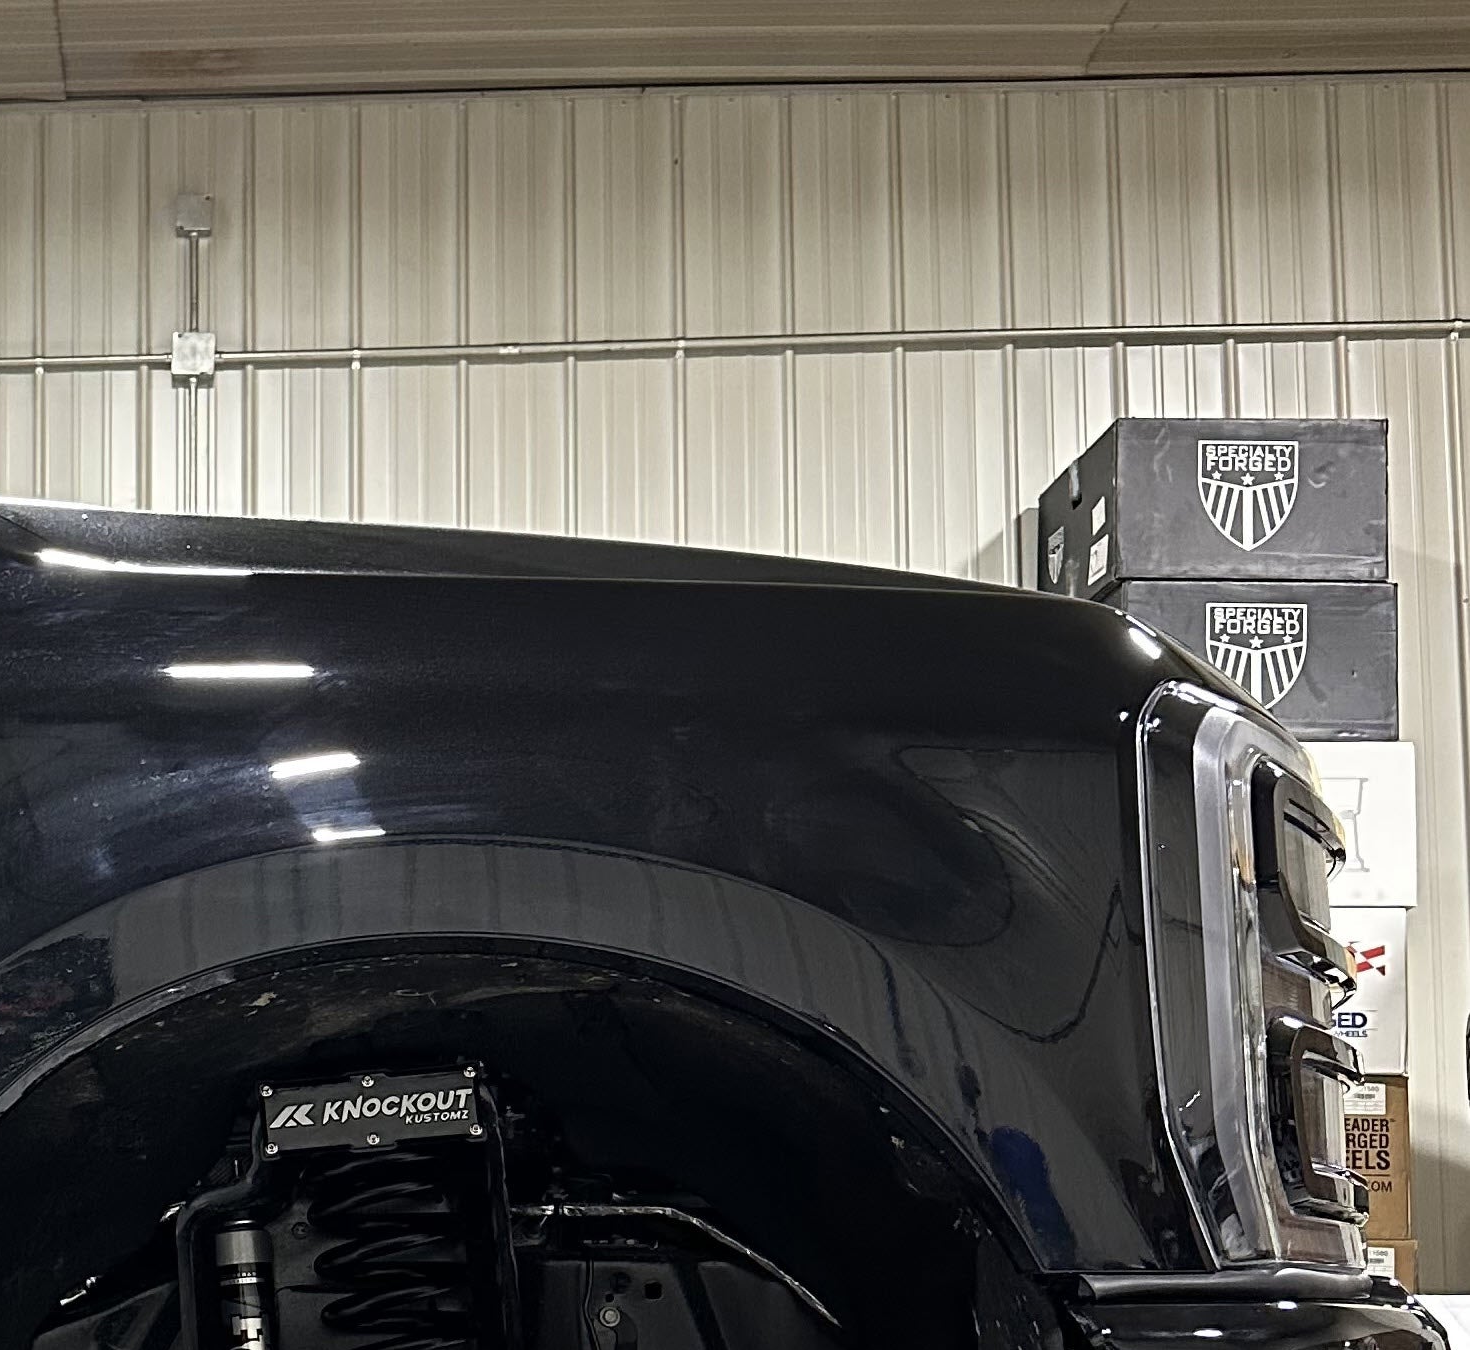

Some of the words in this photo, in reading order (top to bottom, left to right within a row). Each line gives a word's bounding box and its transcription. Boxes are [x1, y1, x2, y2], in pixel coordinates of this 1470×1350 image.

[1206, 446, 1293, 458] SPECIALTY
[1206, 456, 1292, 472] FORGED
[1214, 608, 1301, 620] SPECIALTY
[1215, 619, 1300, 635] FORGED
[323, 1088, 473, 1124] KNOCKOUT
[405, 1109, 470, 1125] KUSTOMZ
[1344, 1118, 1390, 1132] EADER
[1346, 1133, 1390, 1149] RGED
[1370, 1181, 1393, 1192] OM
